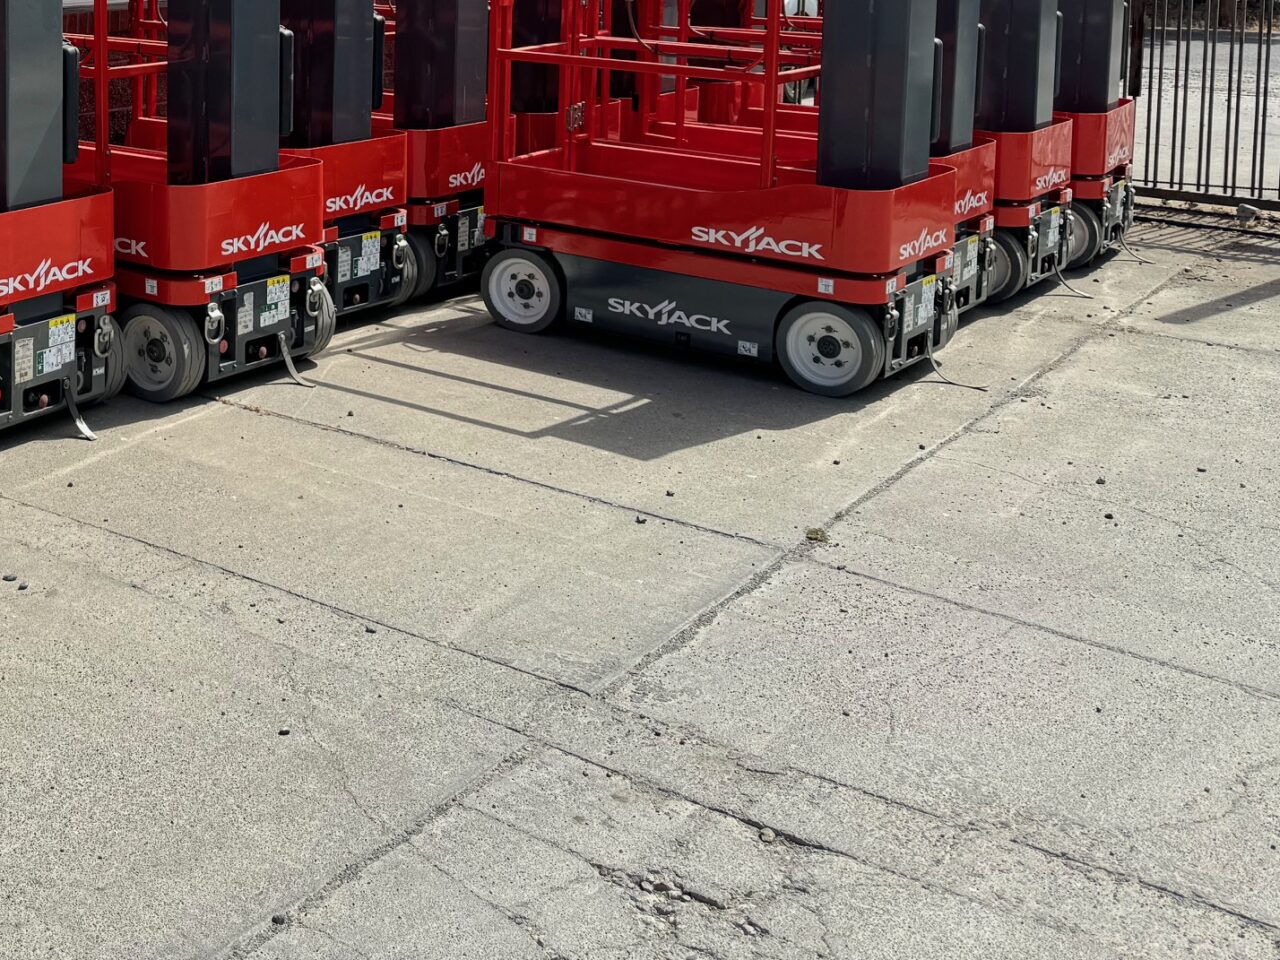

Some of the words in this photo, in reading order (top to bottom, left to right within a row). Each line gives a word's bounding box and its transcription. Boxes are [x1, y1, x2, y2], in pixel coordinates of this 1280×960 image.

[448, 162, 485, 188] SKYJA
[1035, 167, 1067, 190] SKYJACK
[325, 183, 394, 213] SKYJACK
[954, 189, 989, 215] KYJACK
[220, 221, 306, 257] SKYJACK
[691, 225, 825, 261] SKYJACK
[899, 227, 947, 260] SKYJACK
[607, 297, 732, 336] SKYJACK
